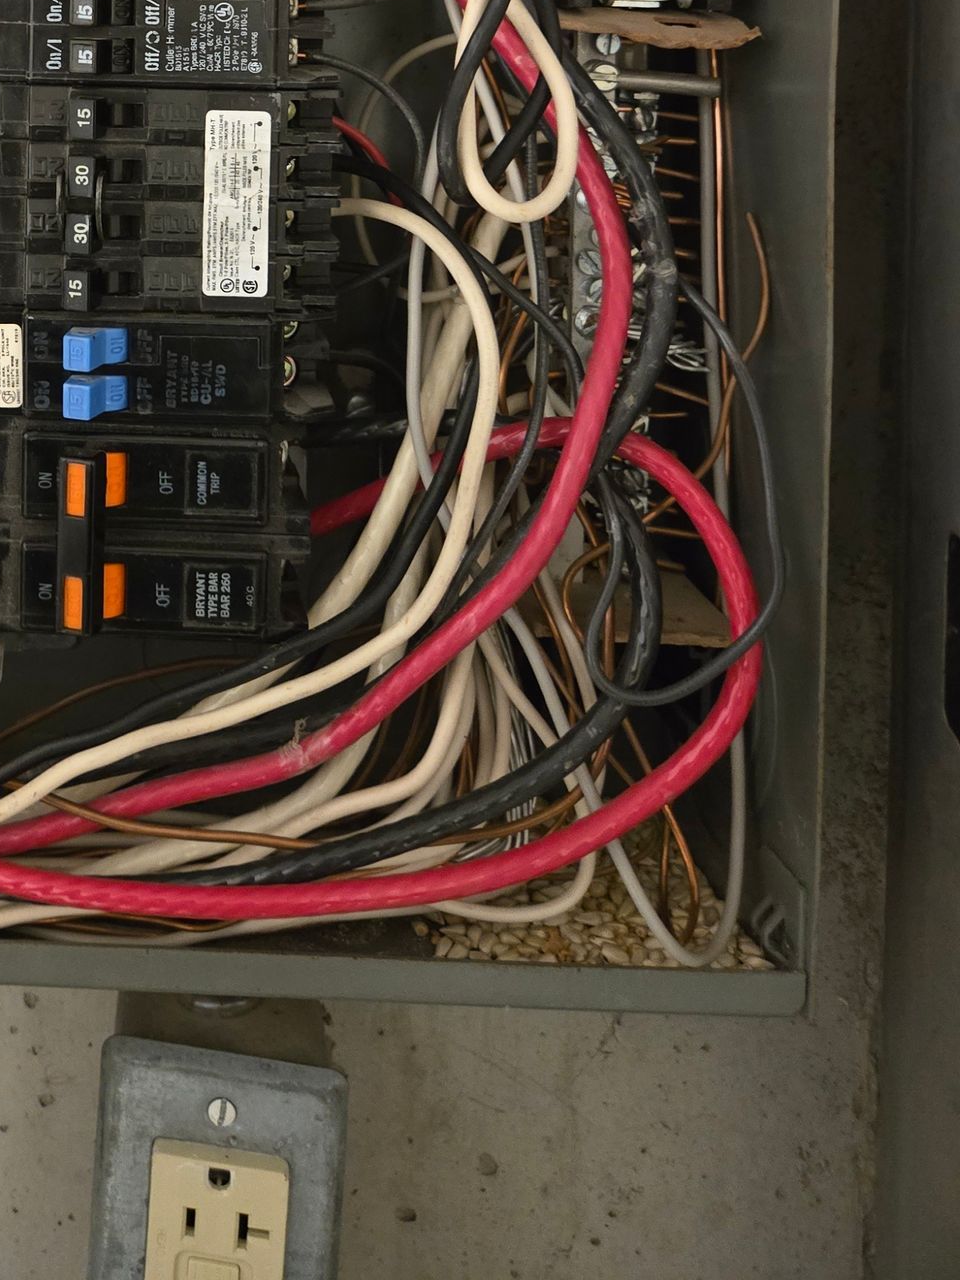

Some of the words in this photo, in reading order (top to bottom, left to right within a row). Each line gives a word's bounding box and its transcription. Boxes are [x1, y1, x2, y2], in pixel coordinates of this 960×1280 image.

[77, 5, 92, 20] 15
[78, 49, 92, 64] 15
[77, 107, 91, 127] 15
[74, 164, 89, 185] 30
[74, 223, 88, 244] 30
[68, 279, 82, 298] 15
[33, 331, 49, 359] ON
[110, 336, 124, 354] ON
[166, 350, 177, 408] BRYANT
[215, 364, 226, 397] SWD
[34, 381, 50, 409] ON
[109, 383, 124, 402] ON
[137, 376, 152, 415] OFF
[38, 472, 52, 489] ON
[159, 470, 174, 495] OFF
[197, 461, 207, 506] COMMON
[210, 472, 220, 495] TRIP
[38, 582, 52, 600] ON
[209, 572, 218, 592] BAR
[221, 572, 231, 593] 260
[155, 582, 171, 608] OFF
[196, 571, 206, 617] BRYANT
[208, 594, 218, 619] TYPE
[220, 596, 230, 618] BAR
